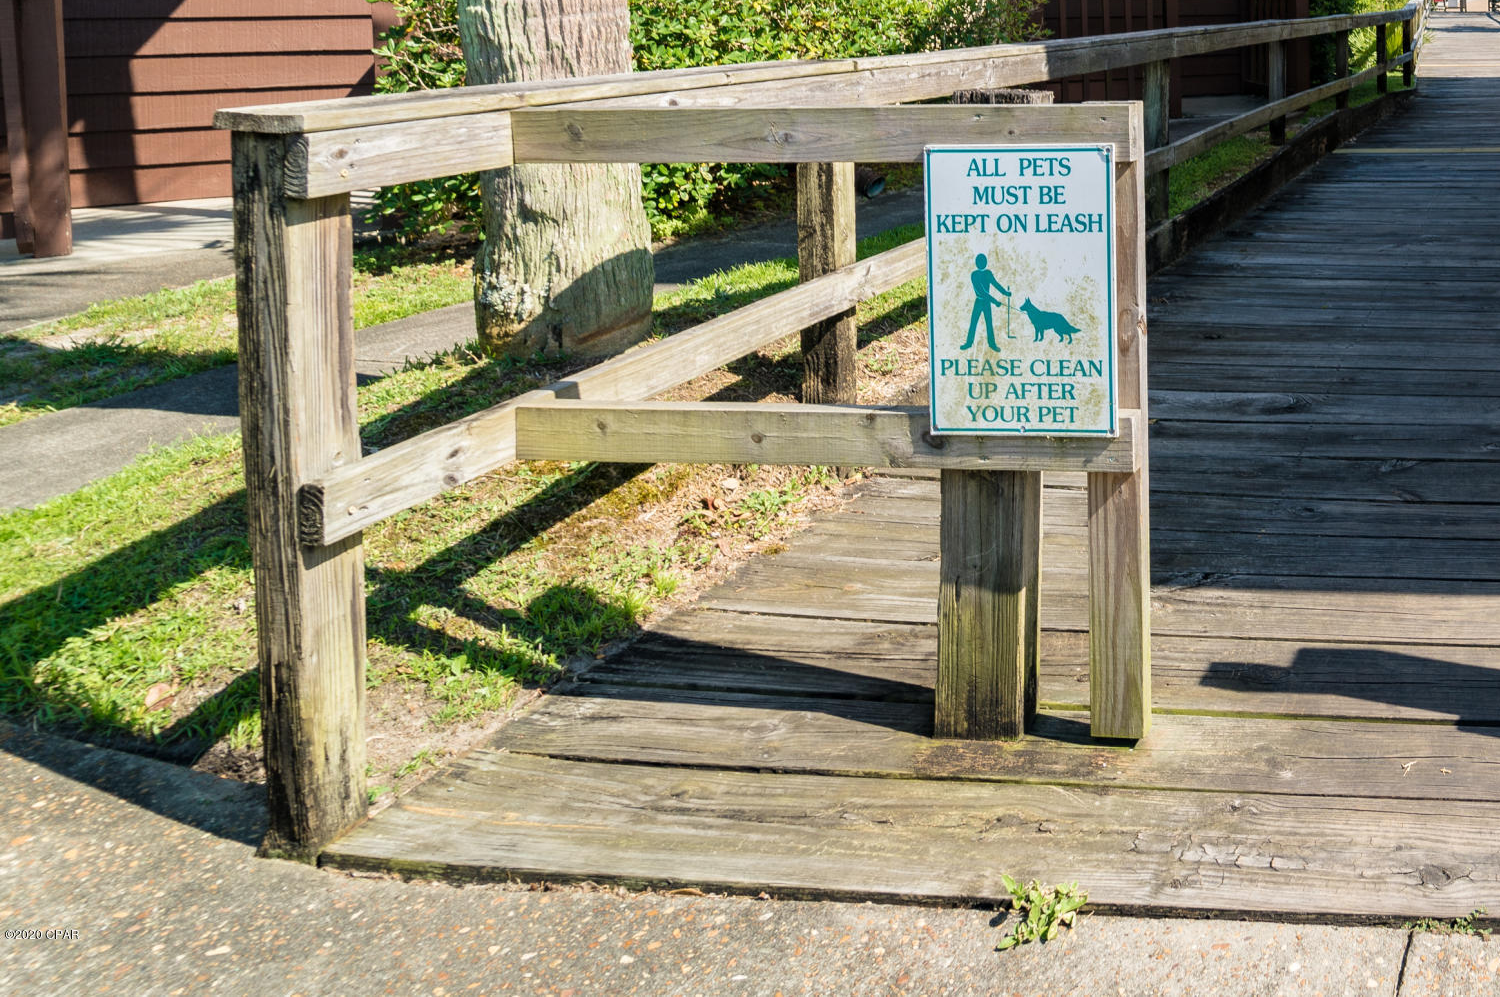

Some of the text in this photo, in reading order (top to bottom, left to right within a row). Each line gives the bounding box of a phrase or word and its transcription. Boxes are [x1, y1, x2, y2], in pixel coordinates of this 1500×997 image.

[966, 157, 1072, 177] ALL PETS
[972, 185, 1067, 205] MUST BE
[936, 213, 1104, 234] KEPT ON LEASH
[940, 358, 1104, 378] PLEASE CLEAN
[968, 382, 1077, 401] UP AFTER
[966, 405, 1080, 424] YOUR PET
